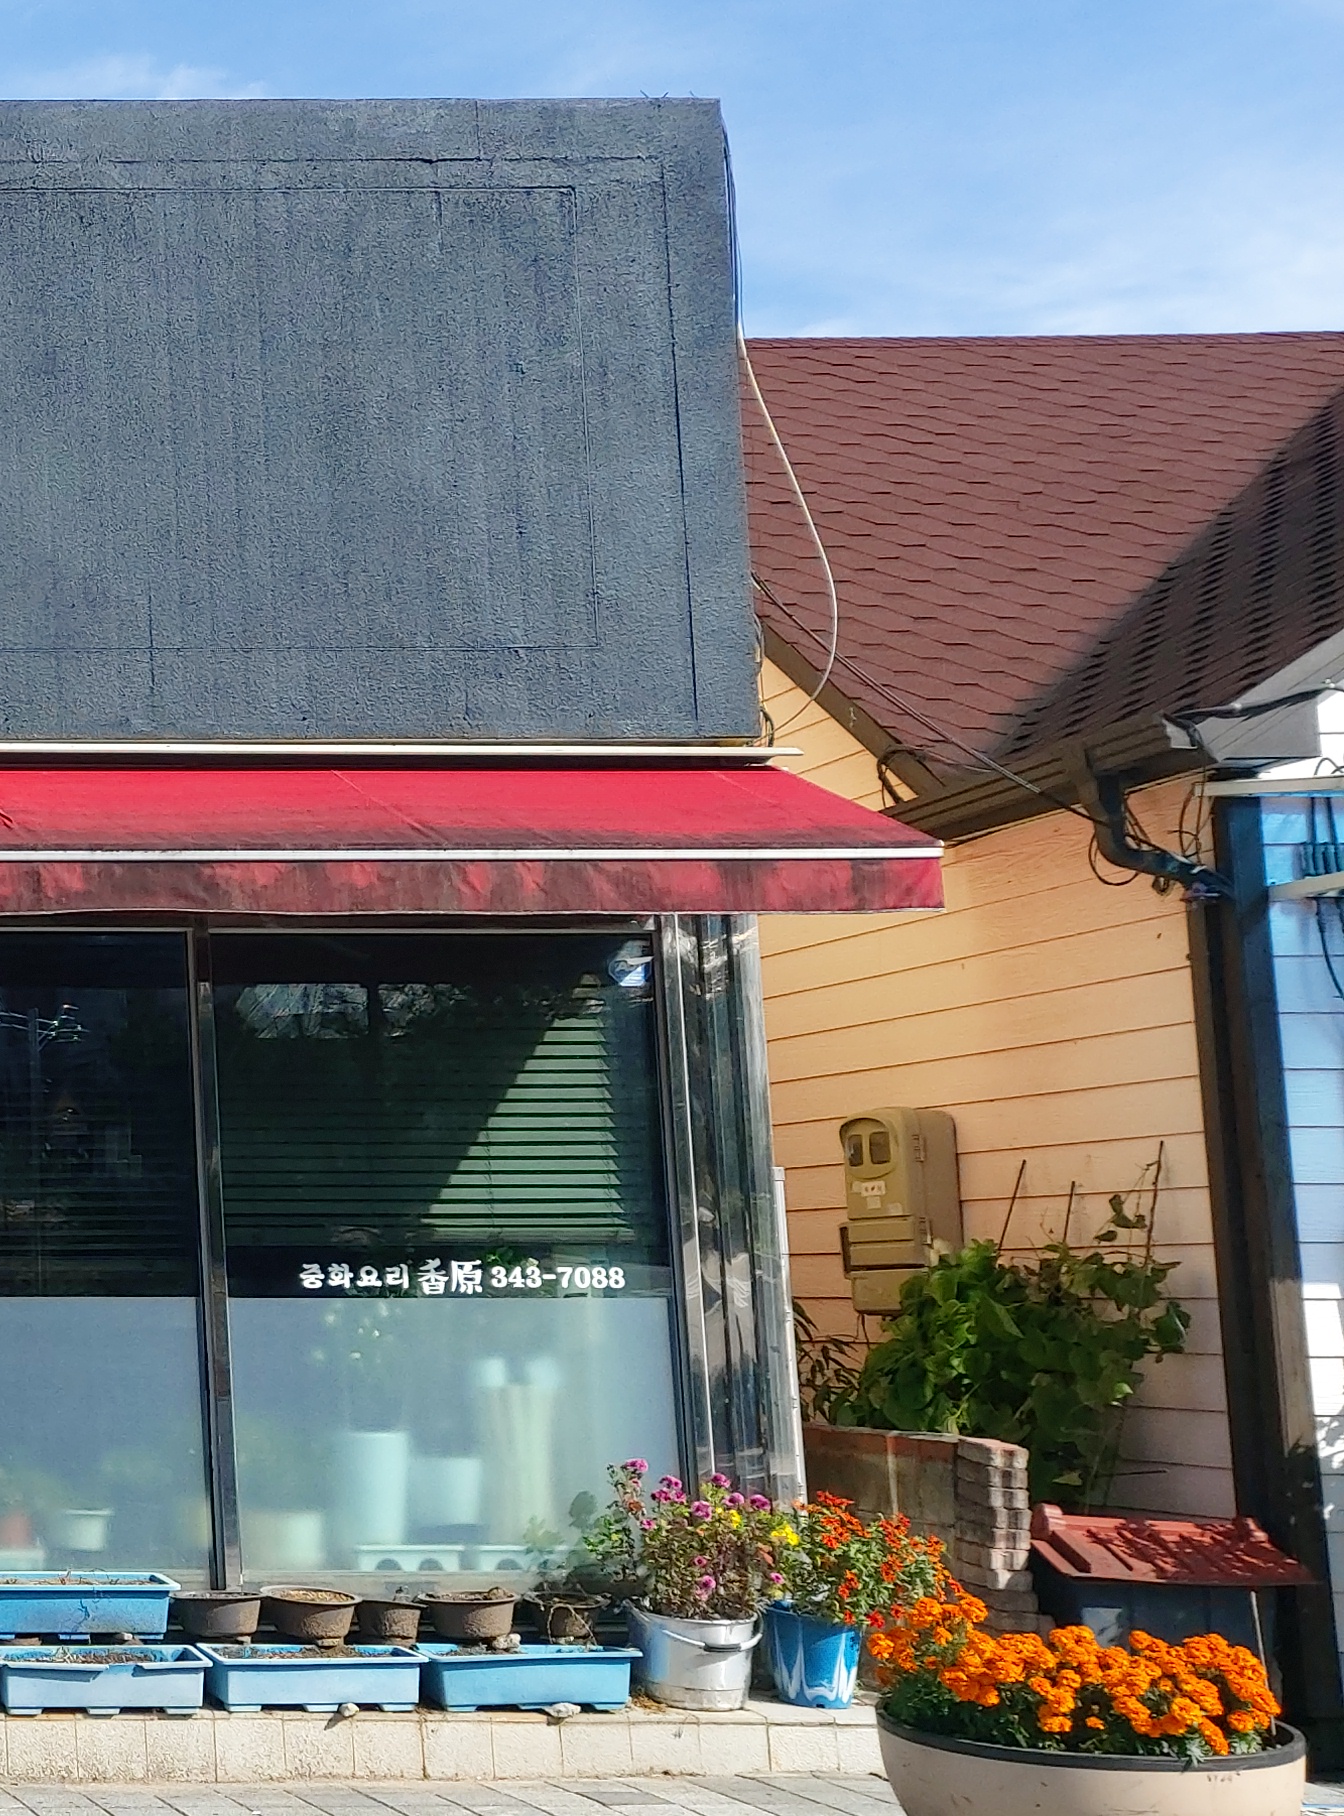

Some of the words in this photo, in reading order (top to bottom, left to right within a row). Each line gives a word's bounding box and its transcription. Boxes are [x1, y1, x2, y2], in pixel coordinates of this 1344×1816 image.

[298, 1264, 409, 1290] 중화요리
[416, 1258, 484, 1296] 香原
[491, 1266, 626, 1289] 343-7088
